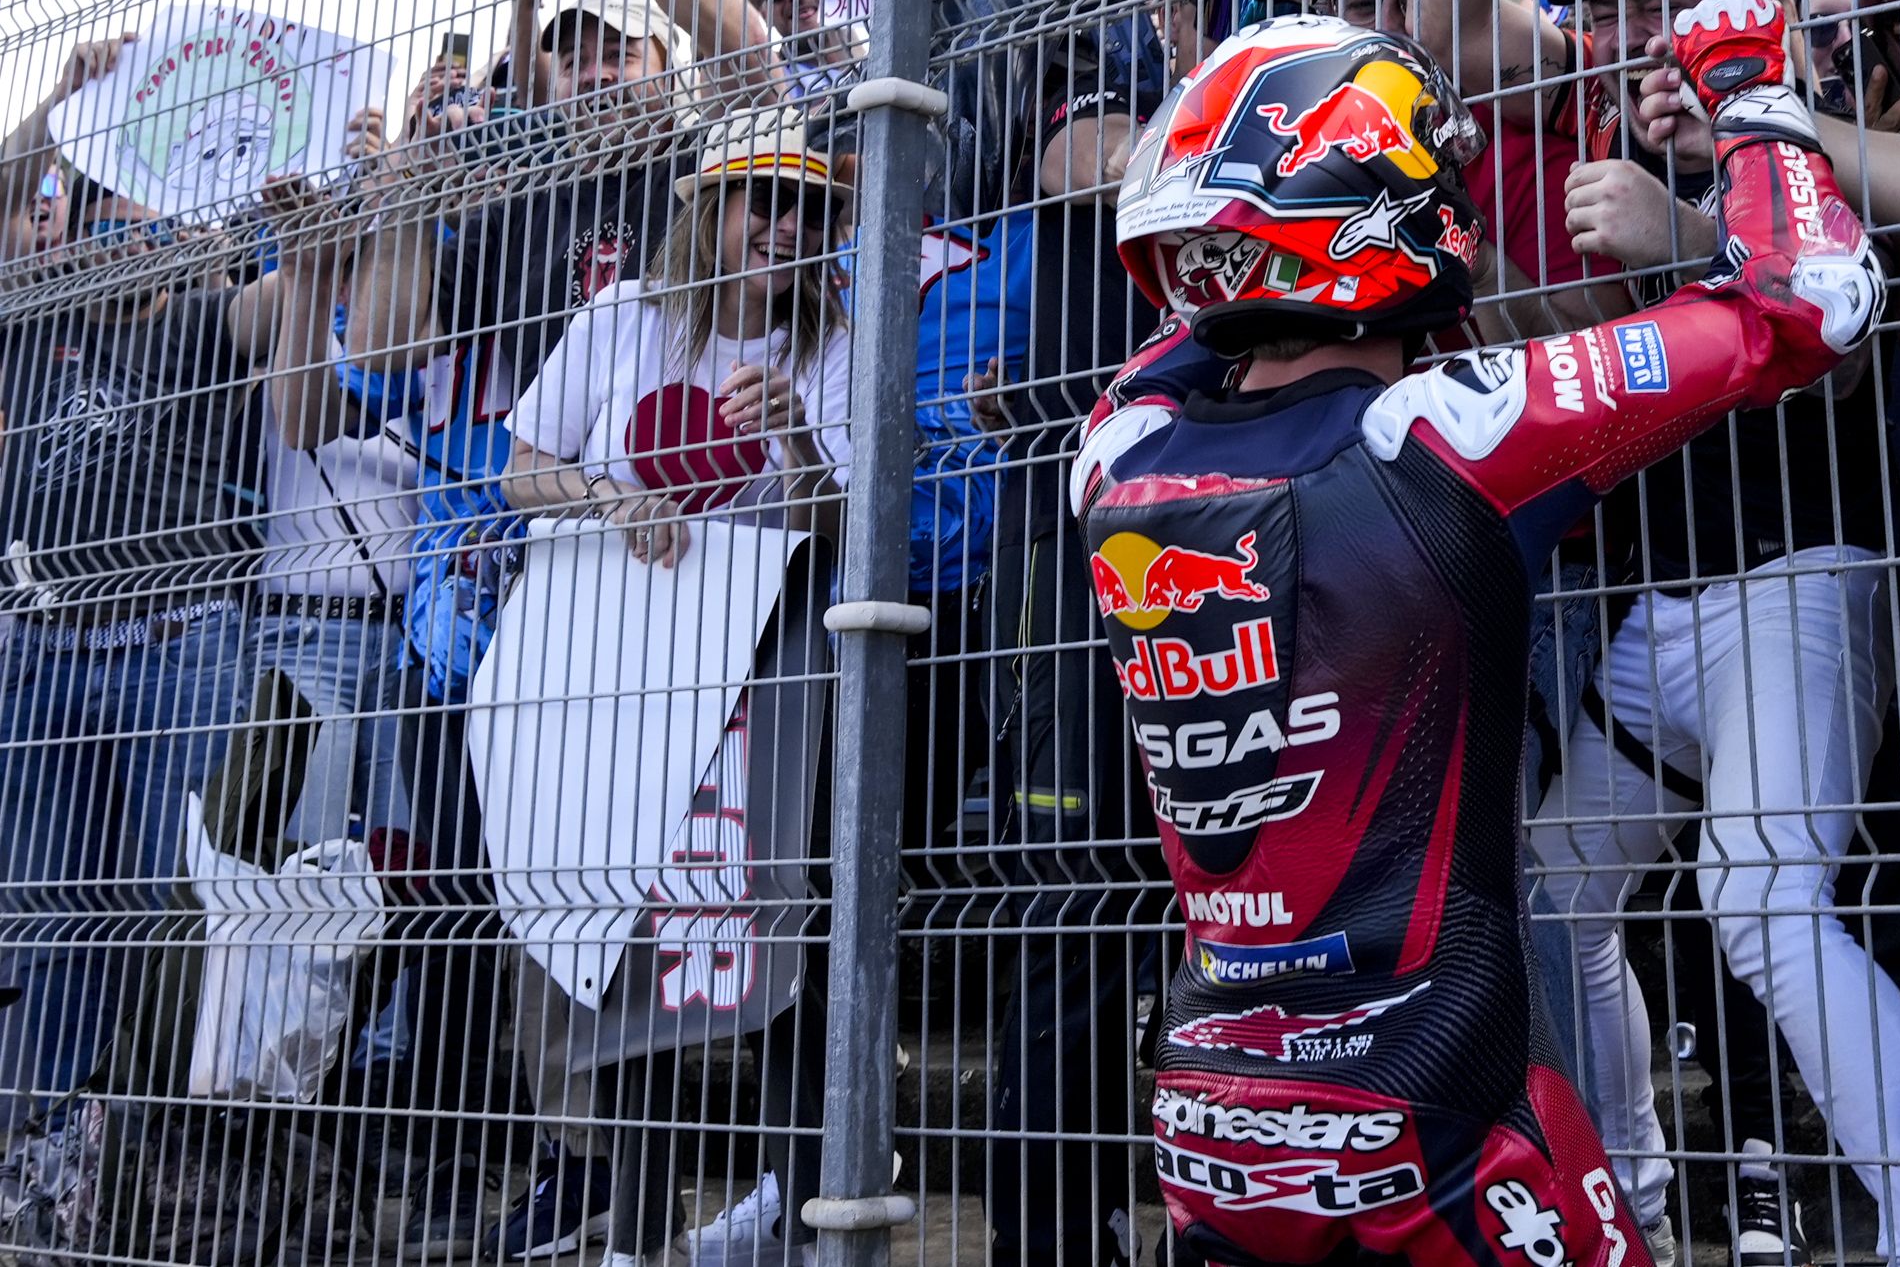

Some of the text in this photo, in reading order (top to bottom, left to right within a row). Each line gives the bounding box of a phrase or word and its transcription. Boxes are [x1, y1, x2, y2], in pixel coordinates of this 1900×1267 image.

[1776, 140, 1827, 244] GASGAS
[1267, 257, 1292, 290] L
[1185, 891, 1293, 927] MOTUL
